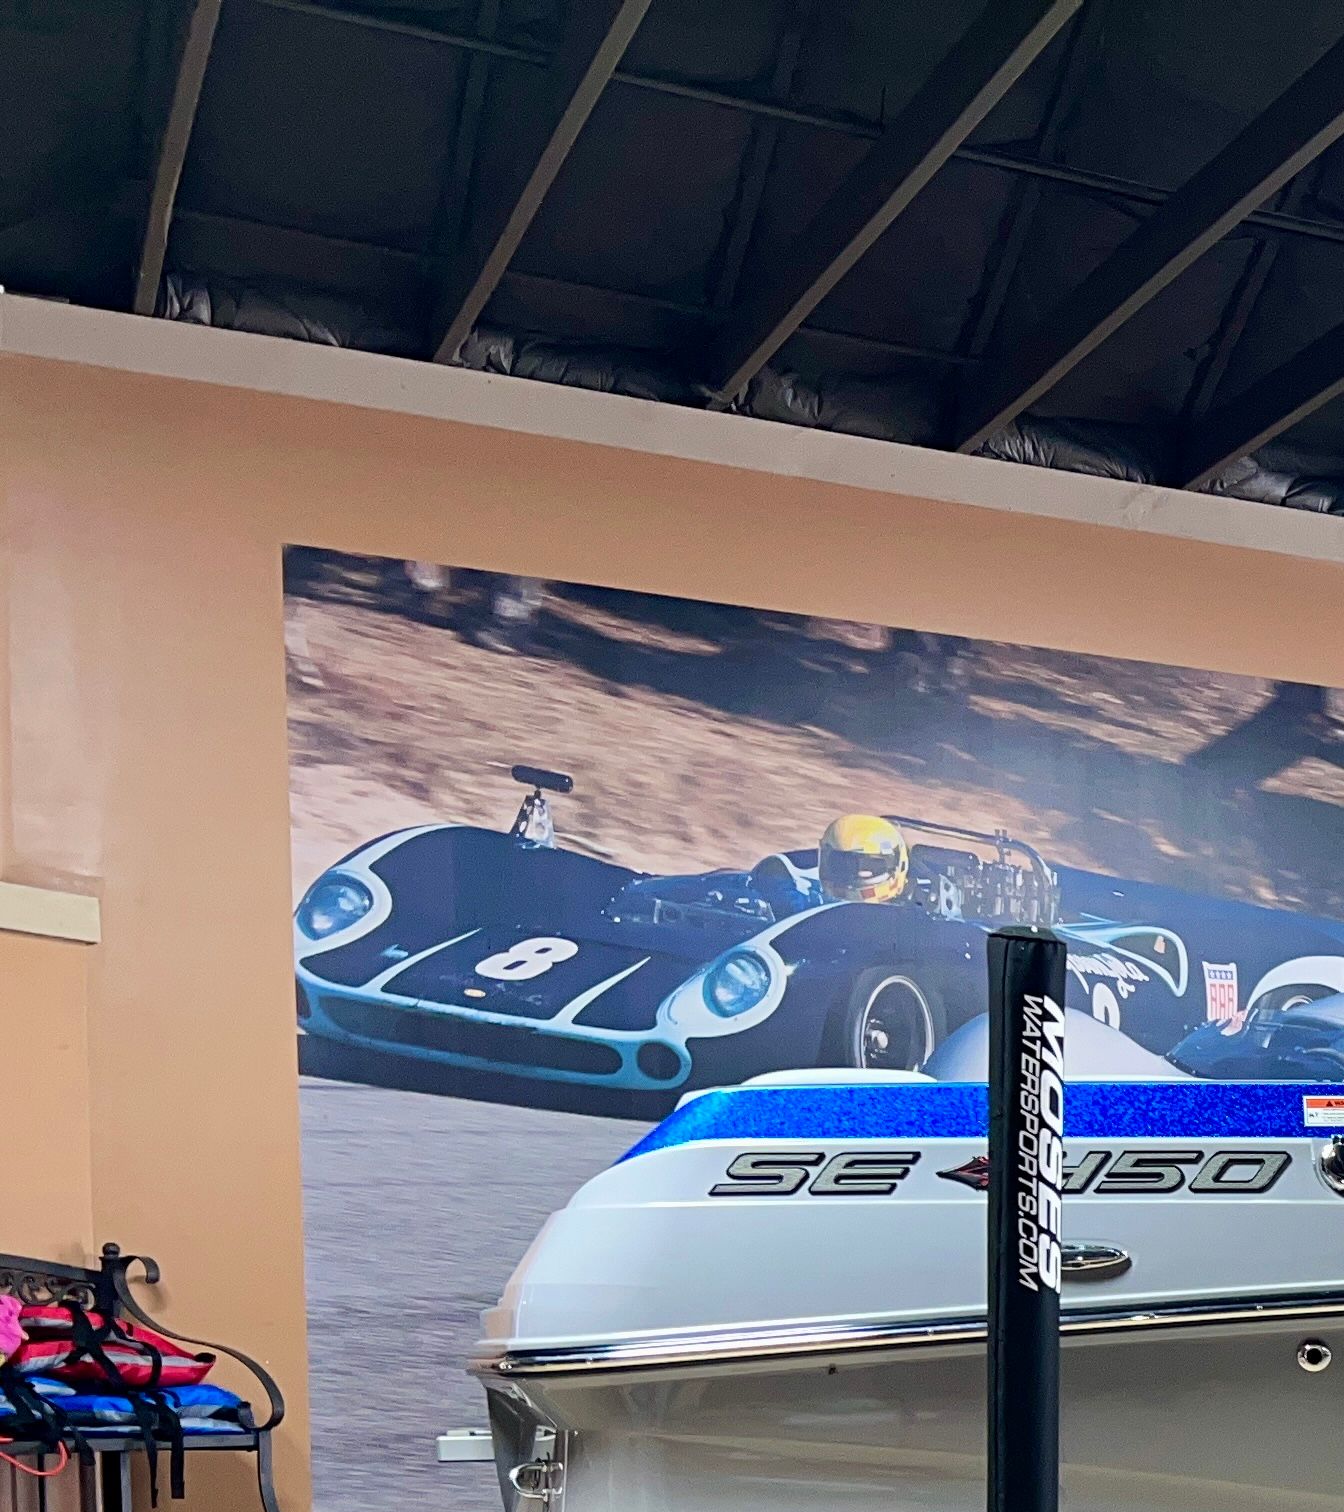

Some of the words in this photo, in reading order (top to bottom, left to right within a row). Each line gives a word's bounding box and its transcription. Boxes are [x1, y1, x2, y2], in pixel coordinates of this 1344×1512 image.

[475, 937, 579, 980] 8
[708, 1152, 922, 1196] SE
[1018, 993, 1043, 1292] WATERSPORTS.COM
[1039, 995, 1065, 1294] MOSES
